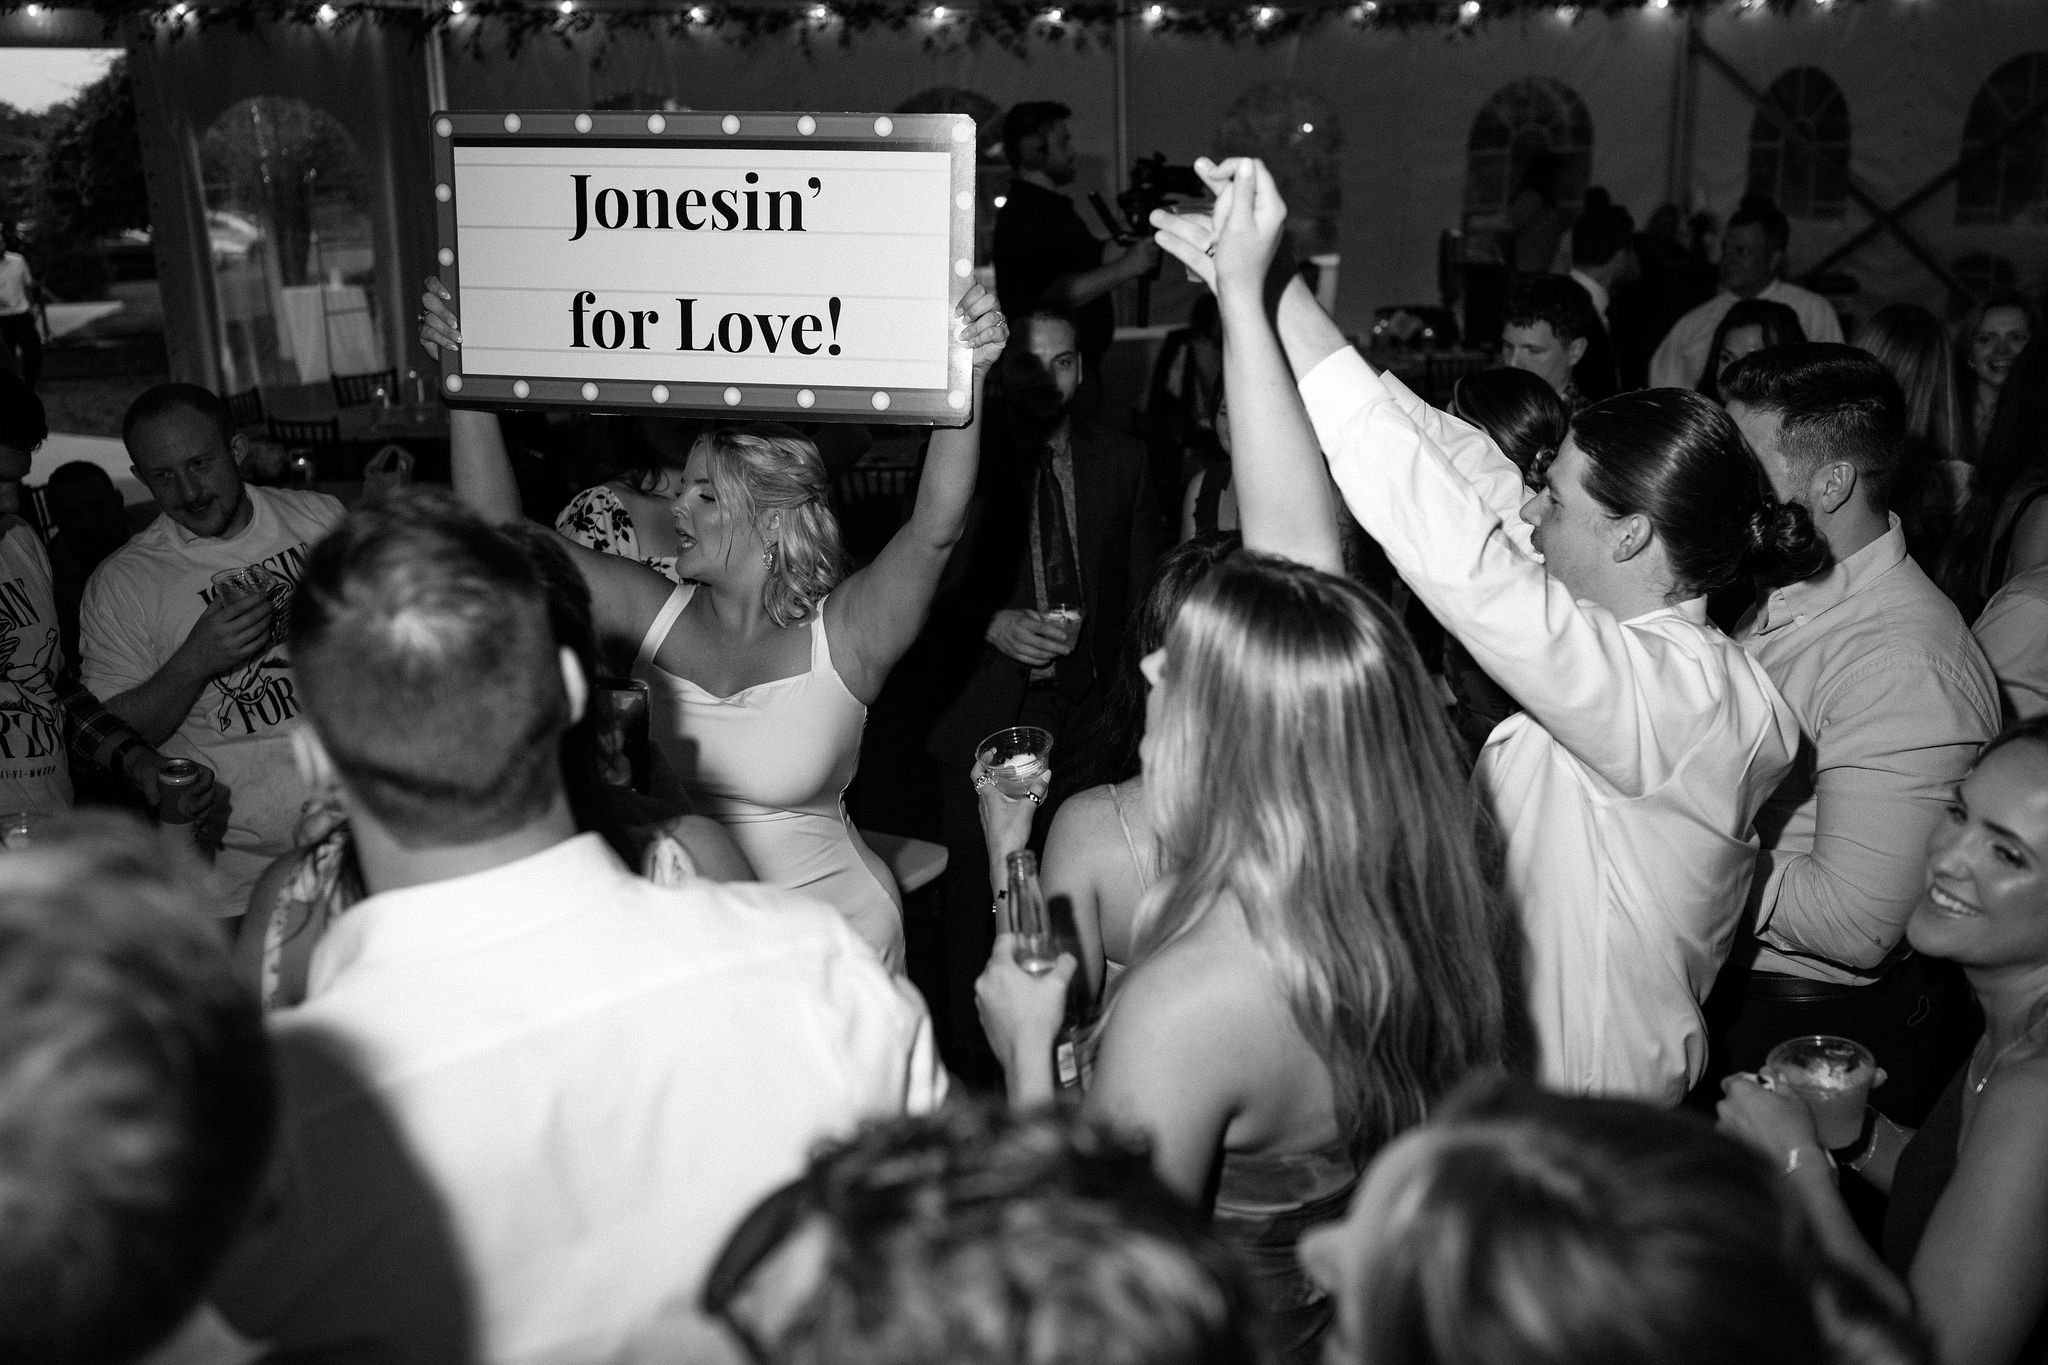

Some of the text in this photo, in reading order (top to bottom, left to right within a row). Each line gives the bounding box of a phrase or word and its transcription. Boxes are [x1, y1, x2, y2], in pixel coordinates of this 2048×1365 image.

[568, 171, 822, 242] Jonesin’
[568, 290, 842, 357] for Love!
[236, 677, 302, 735] FOR
